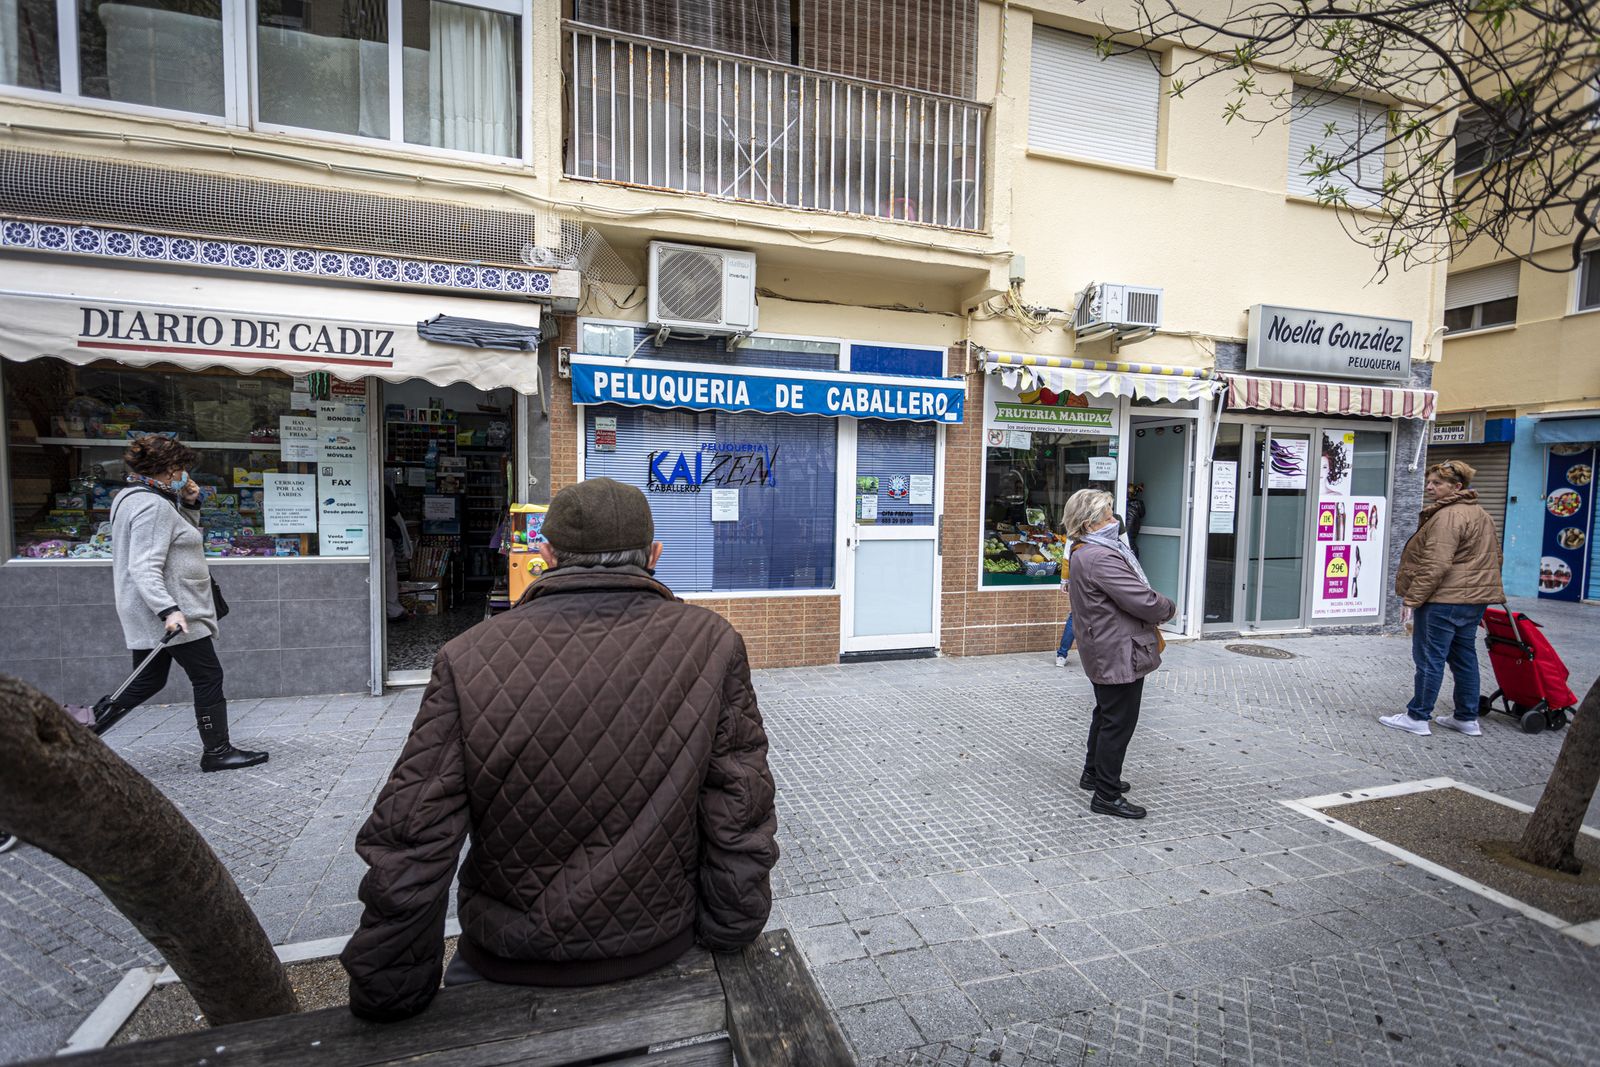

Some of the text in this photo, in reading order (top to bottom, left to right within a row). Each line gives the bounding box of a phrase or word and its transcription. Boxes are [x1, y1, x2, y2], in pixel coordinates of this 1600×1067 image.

[78, 307, 395, 358] DIARIO DE CADIZ
[1267, 315, 1404, 353] Noelia González
[1348, 356, 1401, 371] PELUQUERIA
[594, 371, 948, 416] PELUQUERIA DE CABALLERO
[997, 407, 1111, 423] FRUTERIA MARIPAZ
[701, 442, 764, 453] PELUQUERIA
[649, 484, 701, 493] CABALLEROS
[1330, 562, 1344, 573] 29€
